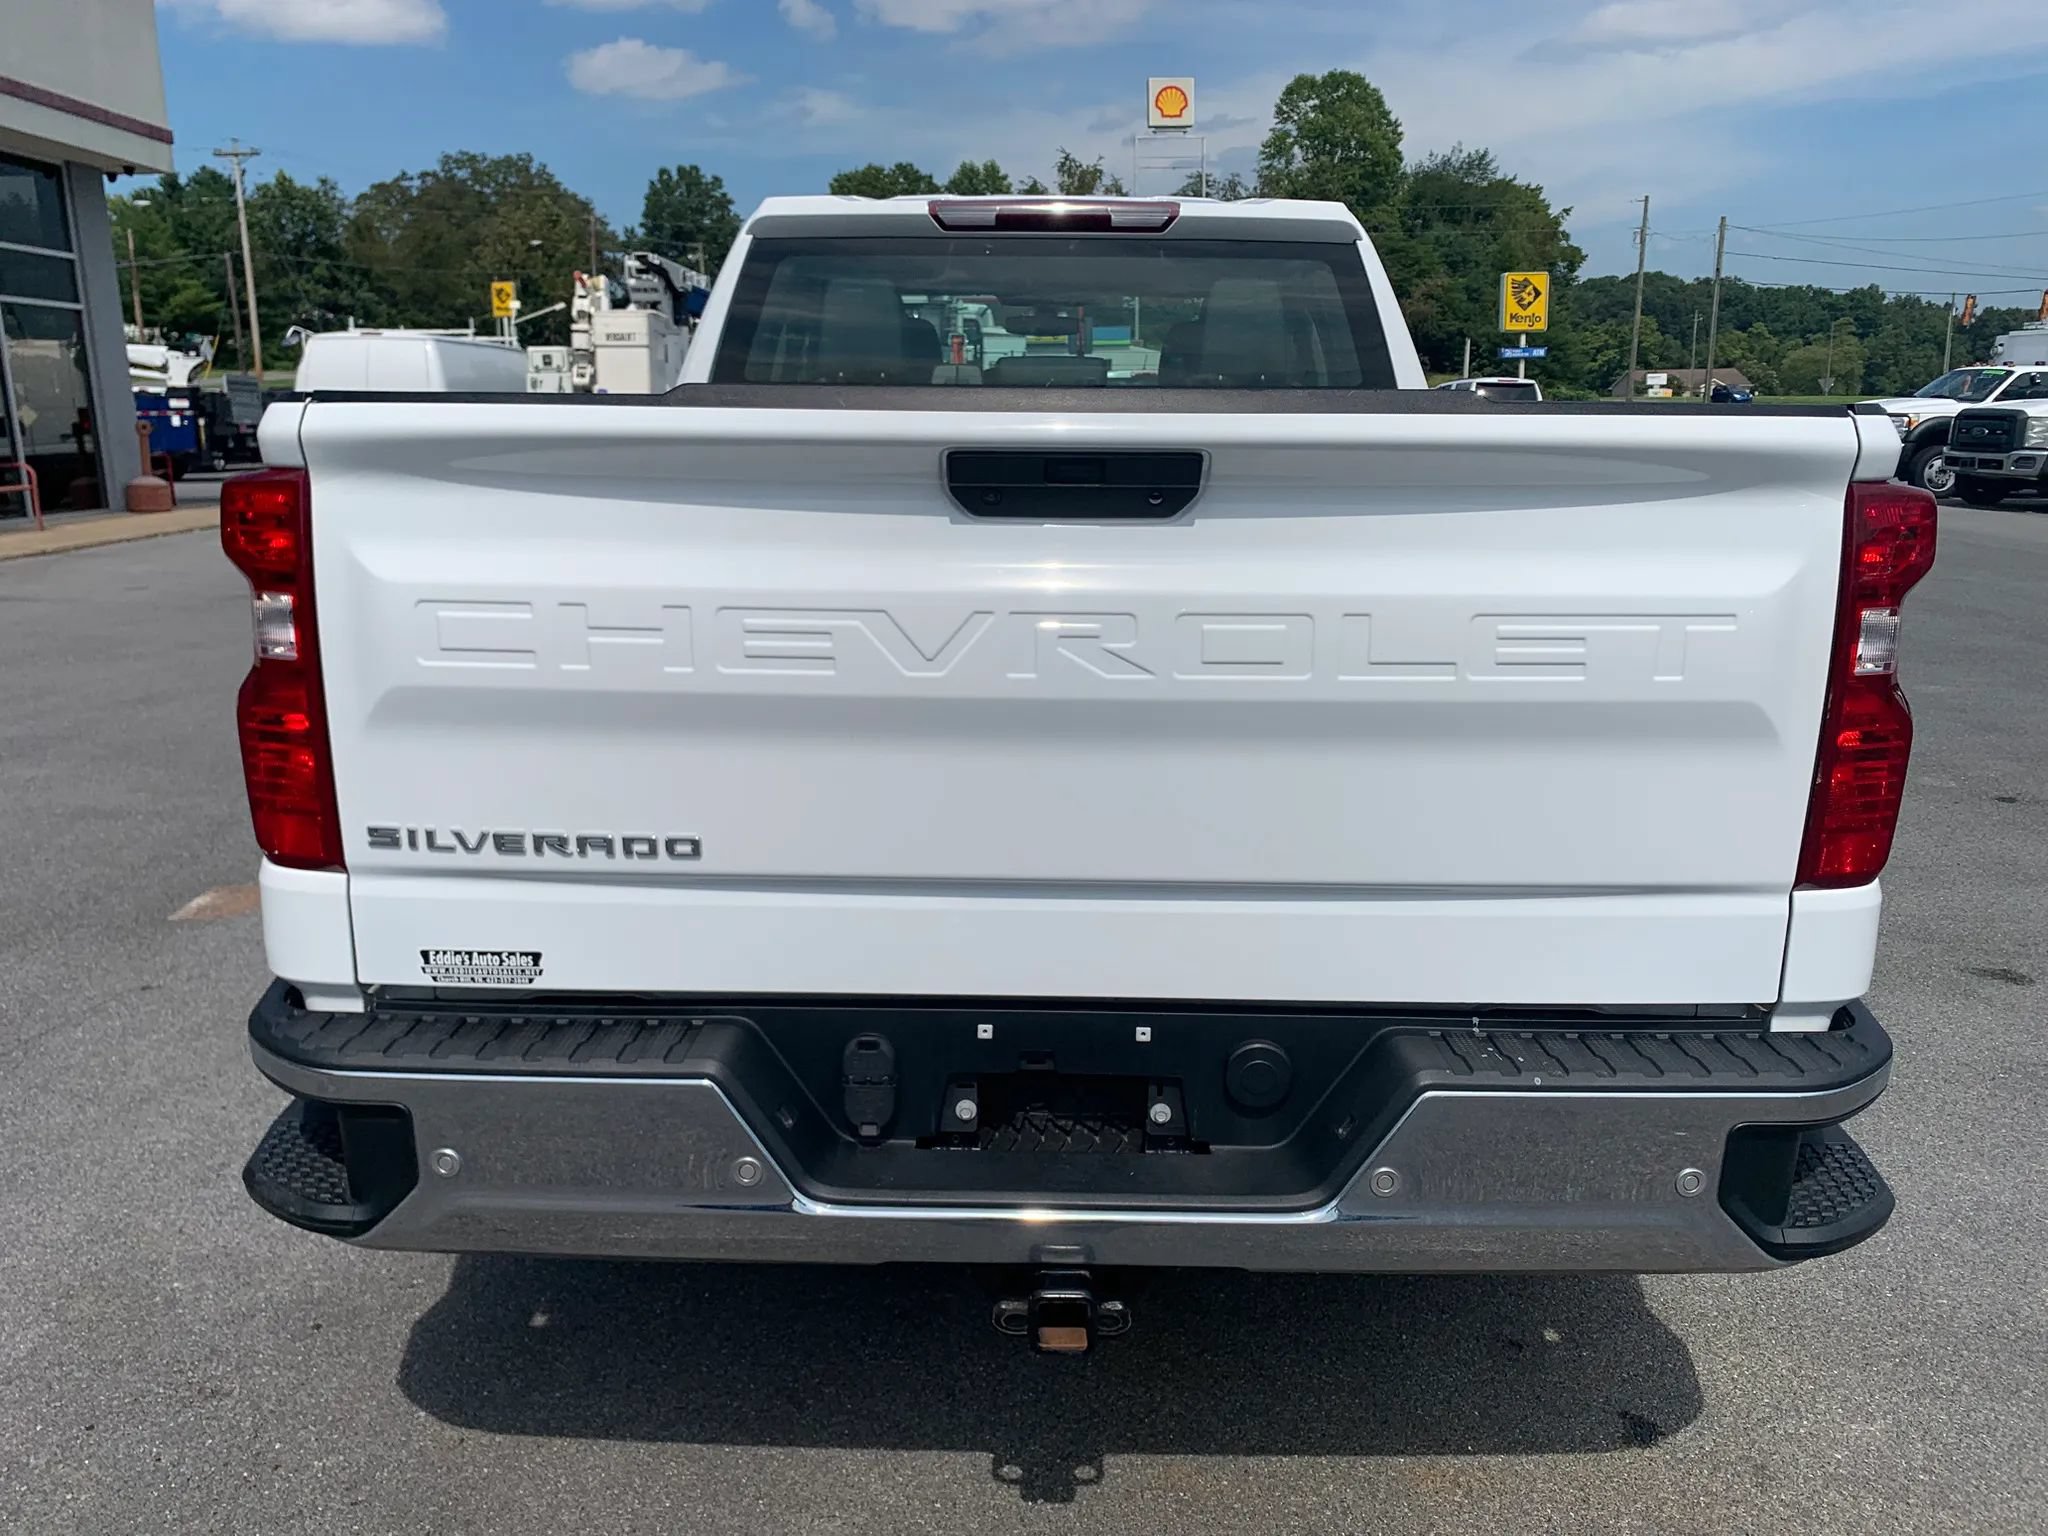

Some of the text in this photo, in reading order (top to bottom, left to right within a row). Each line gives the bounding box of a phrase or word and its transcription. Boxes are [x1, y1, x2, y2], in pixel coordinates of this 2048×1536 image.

[415, 599, 1738, 682] CHEVROLET
[367, 826, 702, 860] SILVERADO
[429, 950, 533, 967] Eddie's Auto Sales
